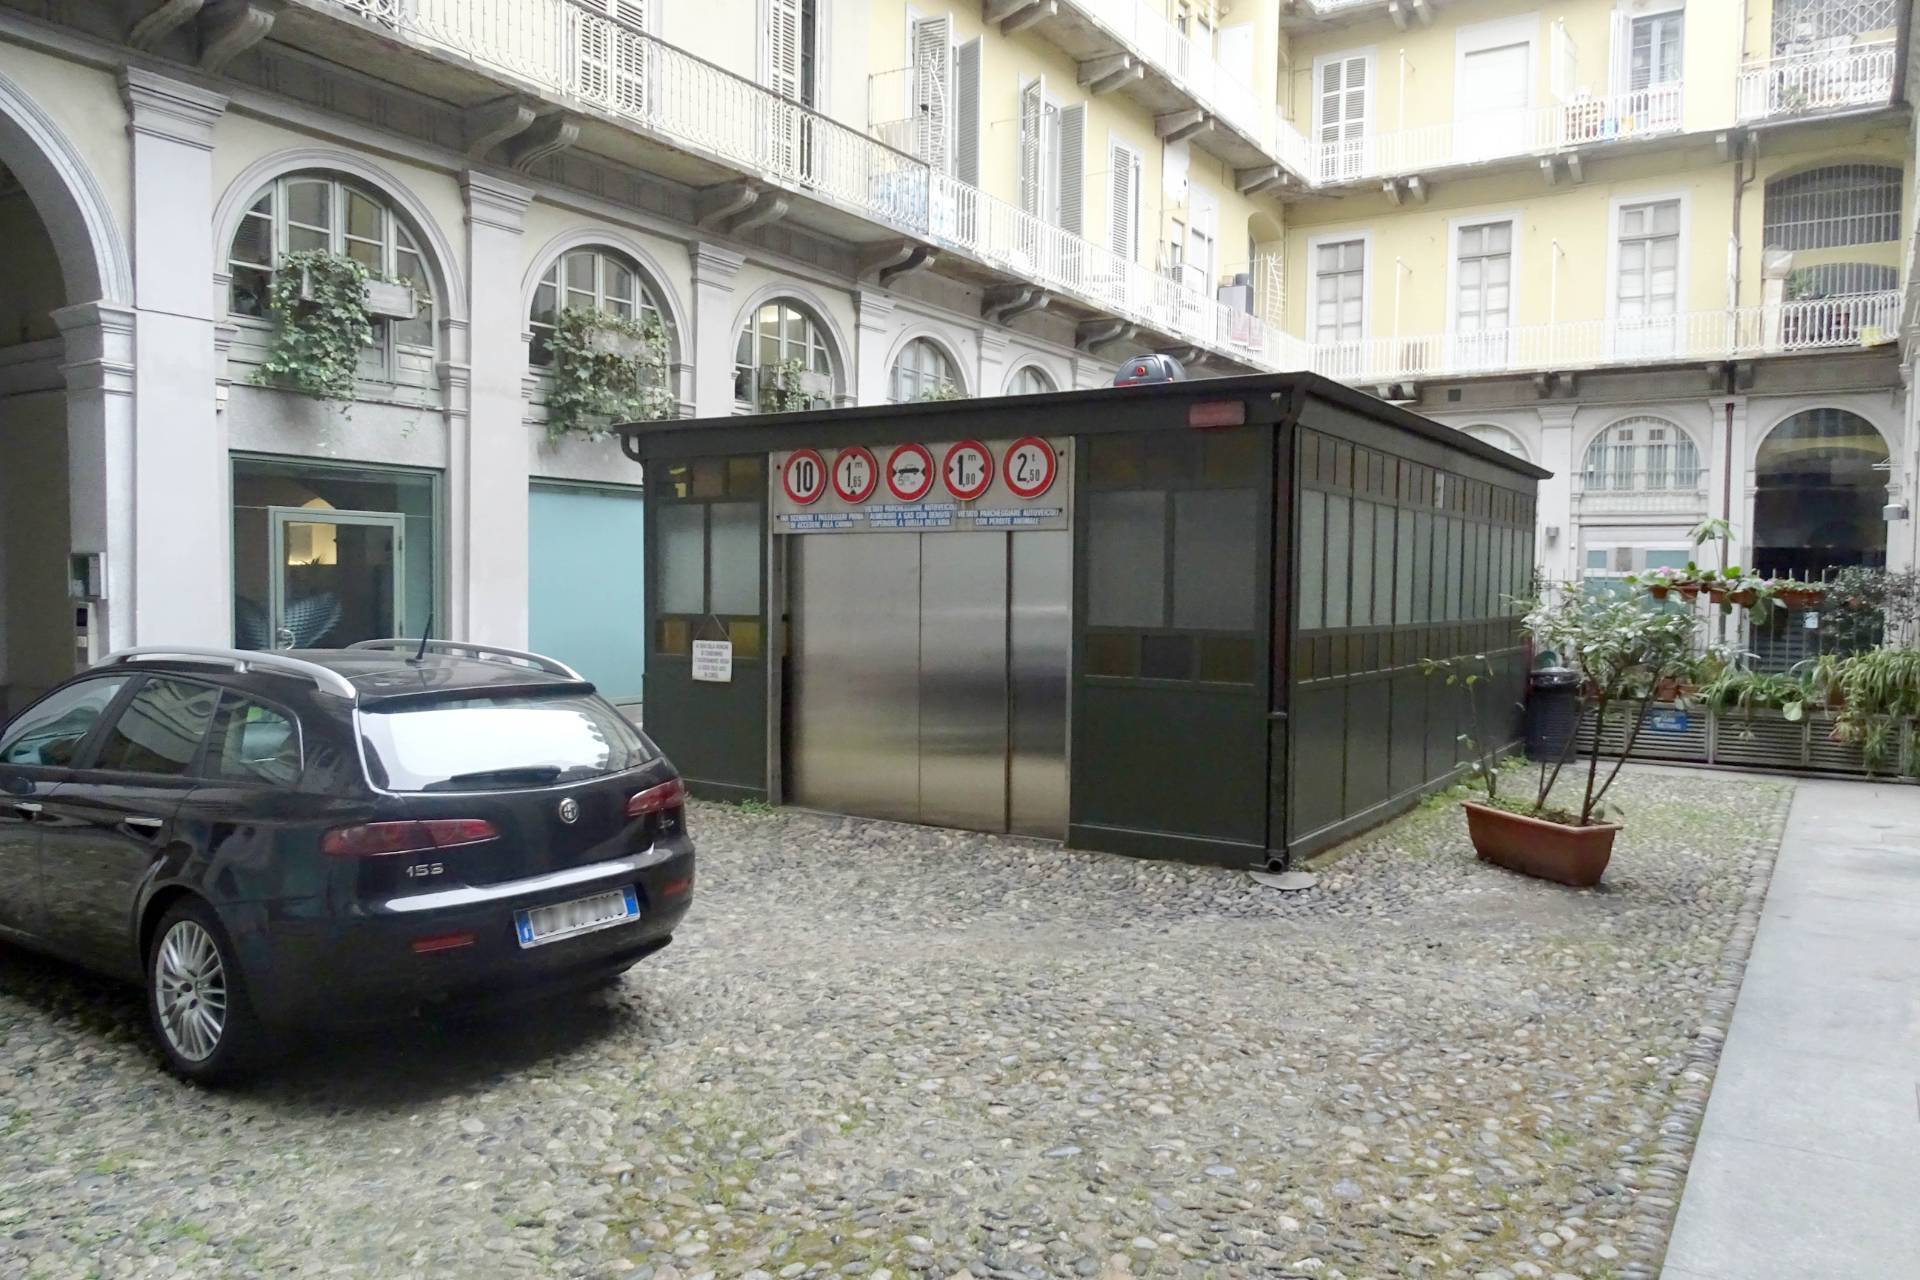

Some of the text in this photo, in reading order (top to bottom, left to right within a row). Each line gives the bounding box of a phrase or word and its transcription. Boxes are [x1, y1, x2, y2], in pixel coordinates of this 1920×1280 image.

[967, 454, 977, 462] m
[1017, 452, 1041, 483] 2,50
[796, 461, 813, 493] 10
